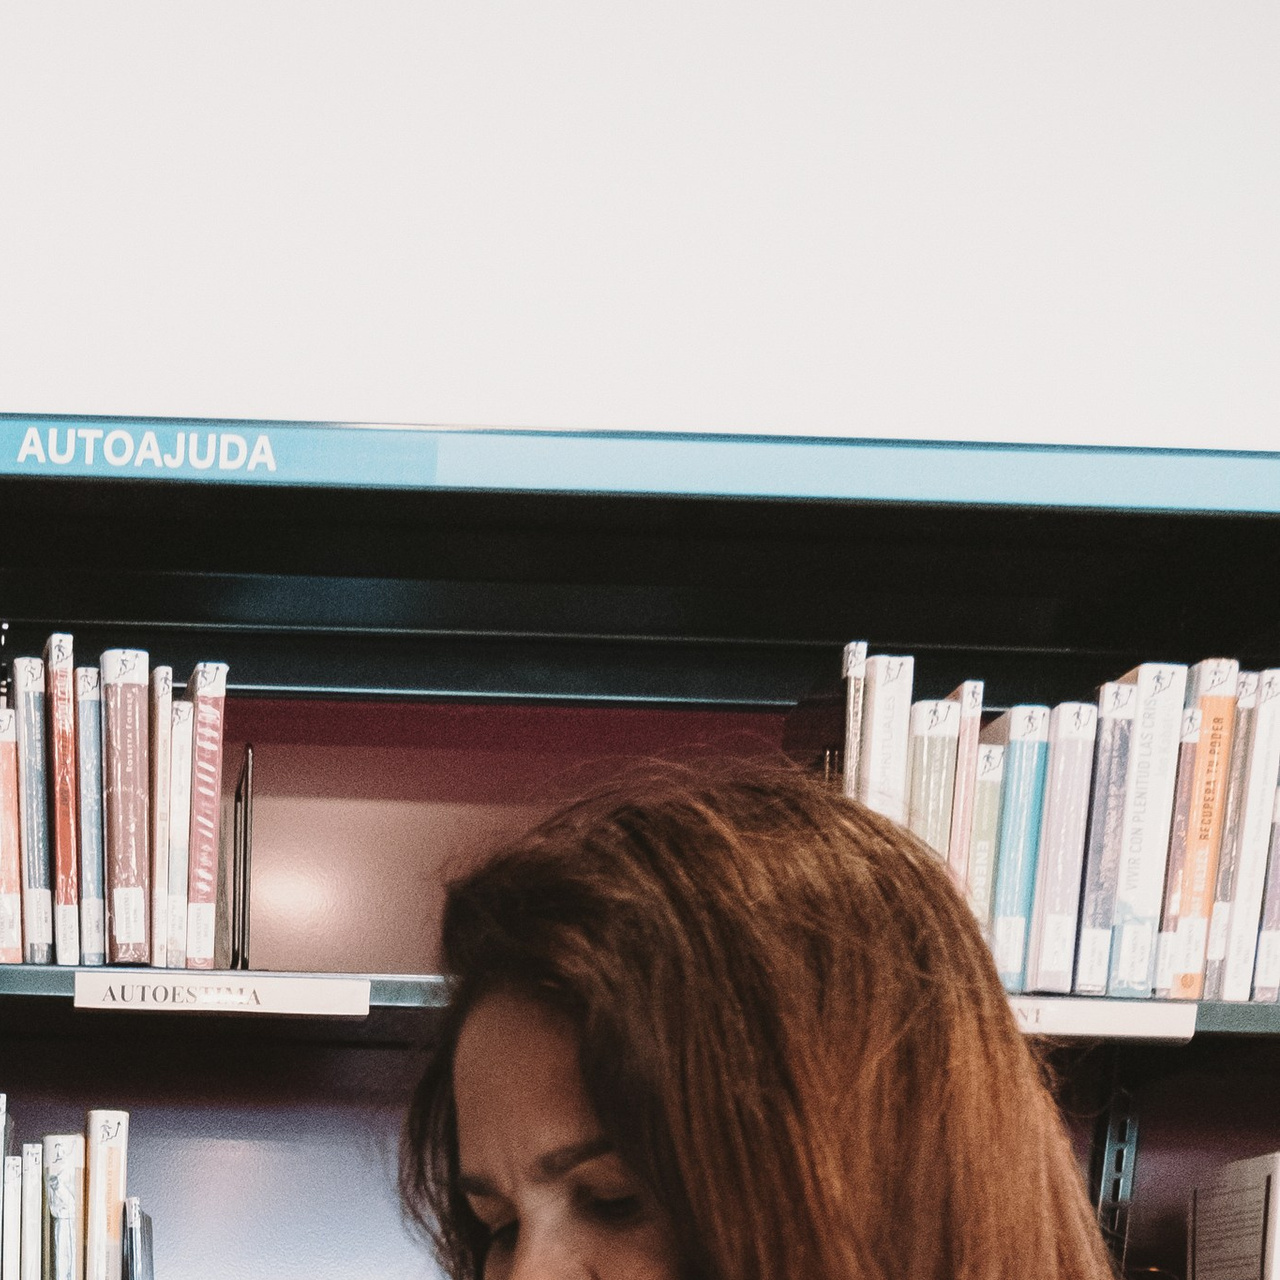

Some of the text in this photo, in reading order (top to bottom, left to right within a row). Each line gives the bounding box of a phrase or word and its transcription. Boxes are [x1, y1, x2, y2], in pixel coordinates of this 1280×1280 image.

[17, 427, 277, 473] AUTOAJUDA
[125, 732, 133, 772] ROSETTA
[1137, 732, 1154, 757] LAS
[1130, 760, 1152, 823] PLENITUD
[1198, 778, 1217, 841] RECUPERA
[1208, 716, 1225, 755] PODER
[1127, 826, 1144, 853] CON
